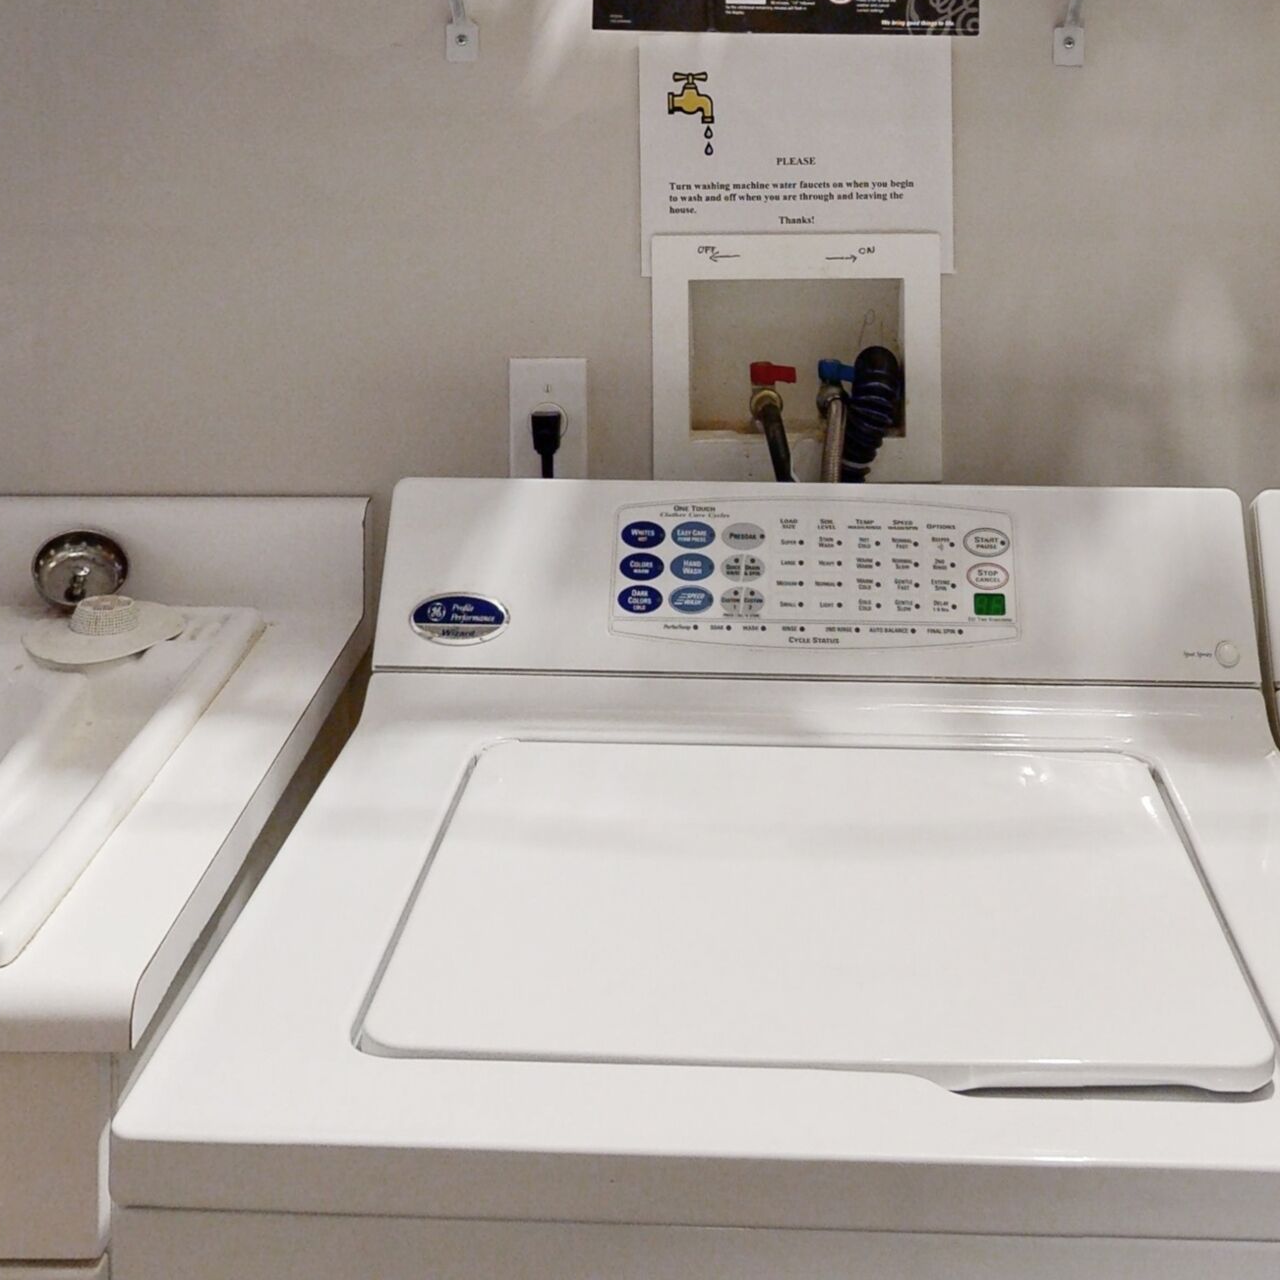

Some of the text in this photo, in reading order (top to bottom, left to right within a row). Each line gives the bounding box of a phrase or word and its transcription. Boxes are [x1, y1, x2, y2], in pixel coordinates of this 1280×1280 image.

[776, 157, 816, 166] PLEASE
[669, 182, 692, 190] Turn
[694, 182, 731, 191] washing
[732, 181, 770, 189] machine
[799, 180, 831, 188] faucets
[871, 181, 888, 190] you
[890, 179, 915, 188] begin
[680, 194, 703, 202] wash
[704, 194, 722, 202] and
[724, 193, 737, 202] off
[738, 193, 762, 201] when
[763, 194, 780, 203] you
[799, 192, 835, 202] through
[836, 192, 854, 200] and
[855, 192, 888, 201] leaving
[889, 192, 904, 200] the
[669, 206, 697, 214] house.
[779, 216, 815, 227] Thanks!
[858, 246, 876, 254] ON
[629, 560, 654, 568] COLORS
[682, 567, 702, 575] WASH
[977, 569, 999, 577] STOP
[627, 596, 652, 604] COLORS
[451, 604, 475, 612] Profile
[450, 614, 495, 623] Performance
